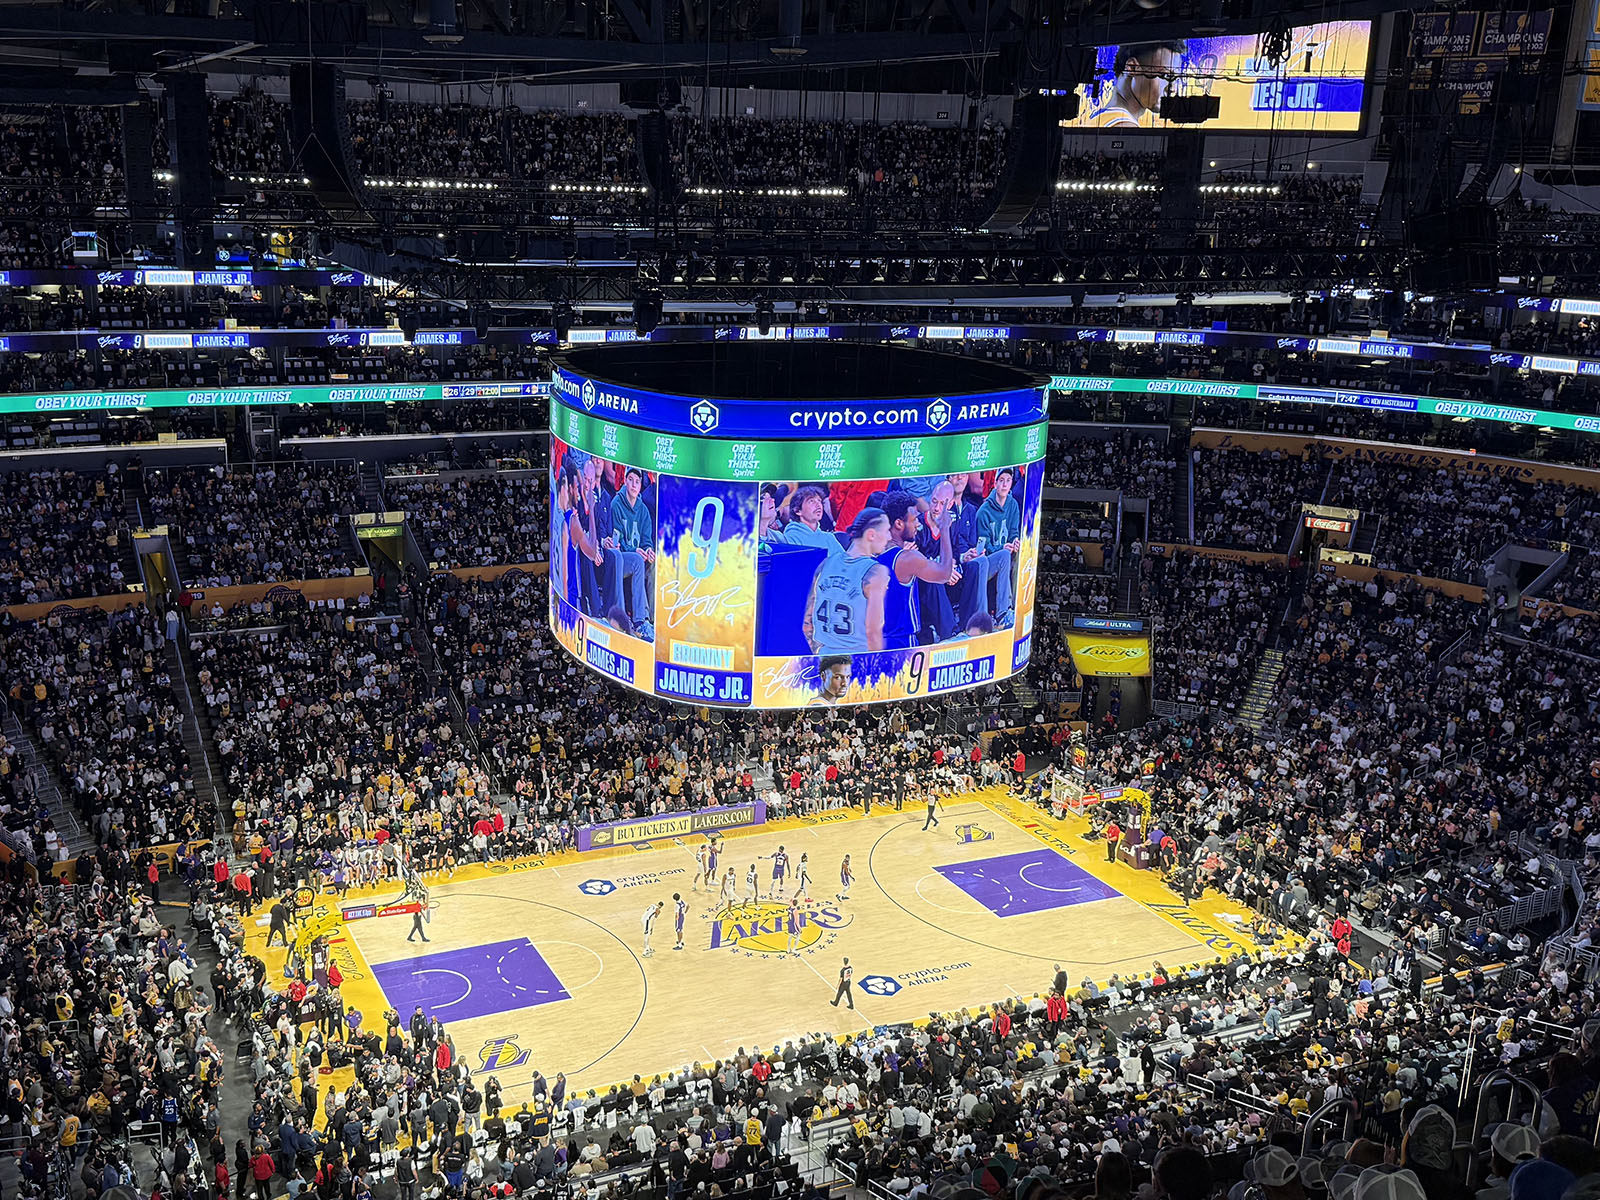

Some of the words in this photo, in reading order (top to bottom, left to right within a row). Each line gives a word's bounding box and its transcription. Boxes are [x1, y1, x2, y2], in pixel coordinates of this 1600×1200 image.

[134, 271, 142, 284] 9
[198, 273, 232, 284] JAMES
[234, 273, 250, 284] JR.
[1550, 298, 1560, 312] 9
[608, 332, 636, 342] JAMES
[739, 328, 746, 339] 9
[816, 328, 828, 338] JR.
[918, 326, 925, 338] 9
[966, 328, 994, 338] JAMES
[996, 328, 1009, 338] JR.
[1106, 330, 1114, 342] 9
[1158, 332, 1187, 344] JAMES
[1188, 334, 1204, 344] JR.
[134, 335, 142, 348] 9
[196, 336, 230, 347] JAMES
[232, 336, 248, 346] JR.
[360, 333, 366, 346] 9
[414, 334, 444, 344] JAMES
[446, 333, 461, 344] JR.
[1308, 338, 1316, 350] 9
[1363, 343, 1394, 355] JAMES
[1396, 345, 1411, 356] JR.
[1522, 356, 1530, 368] 9
[1581, 362, 1600, 374] JAM
[1051, 376, 1079, 389] YOUR
[1146, 382, 1172, 392] OBEY
[1174, 382, 1203, 393] YOUR
[328, 390, 358, 401] OBEY
[358, 389, 390, 400] YOUR
[449, 387, 458, 396] 26
[464, 386, 474, 396] 29
[35, 396, 68, 409] OBEY
[69, 396, 102, 408] YOUR
[187, 393, 218, 404] OBEY
[219, 392, 251, 404] YOUR
[598, 392, 638, 414] ARENA
[1340, 394, 1358, 404] 7:47
[790, 406, 918, 430] crypto.com
[957, 401, 1010, 420] ARENA
[1435, 402, 1465, 414] OBEY
[1466, 404, 1496, 418] YOUR
[656, 436, 674, 447] OBEY
[900, 440, 922, 450] OBEY
[970, 434, 988, 444] OBEY
[656, 444, 674, 454] YOUR
[732, 444, 756, 454] OBEY
[818, 444, 842, 454] OBEY
[901, 448, 920, 458] YOUR
[733, 452, 756, 460] YOUR
[820, 452, 842, 460] YOUR
[732, 468, 755, 478] Sprite
[819, 468, 840, 477] Sprite
[900, 464, 920, 474] Sprite
[688, 496, 724, 579] 9
[816, 599, 853, 636] 43
[576, 616, 585, 656] 9
[586, 639, 616, 674] JAMES
[616, 656, 634, 682] JR.
[673, 642, 734, 668] BRONNY
[906, 651, 925, 695] 9
[931, 660, 972, 690] JAMES
[974, 658, 993, 682] JR.
[659, 667, 716, 698] JAMES
[719, 676, 750, 700] JR.
[617, 826, 633, 840] BUY
[633, 820, 668, 838] TICKETS
[670, 818, 688, 833] AT
[694, 808, 752, 830] LAKERS.COM
[820, 814, 848, 822] AT&T
[1034, 828, 1076, 856] ULTRA
[512, 860, 545, 871] AT&T
[616, 867, 686, 884] crypto.com
[622, 878, 662, 888] ARENA
[898, 960, 972, 980] crypto.com
[907, 974, 949, 987] ARENA
